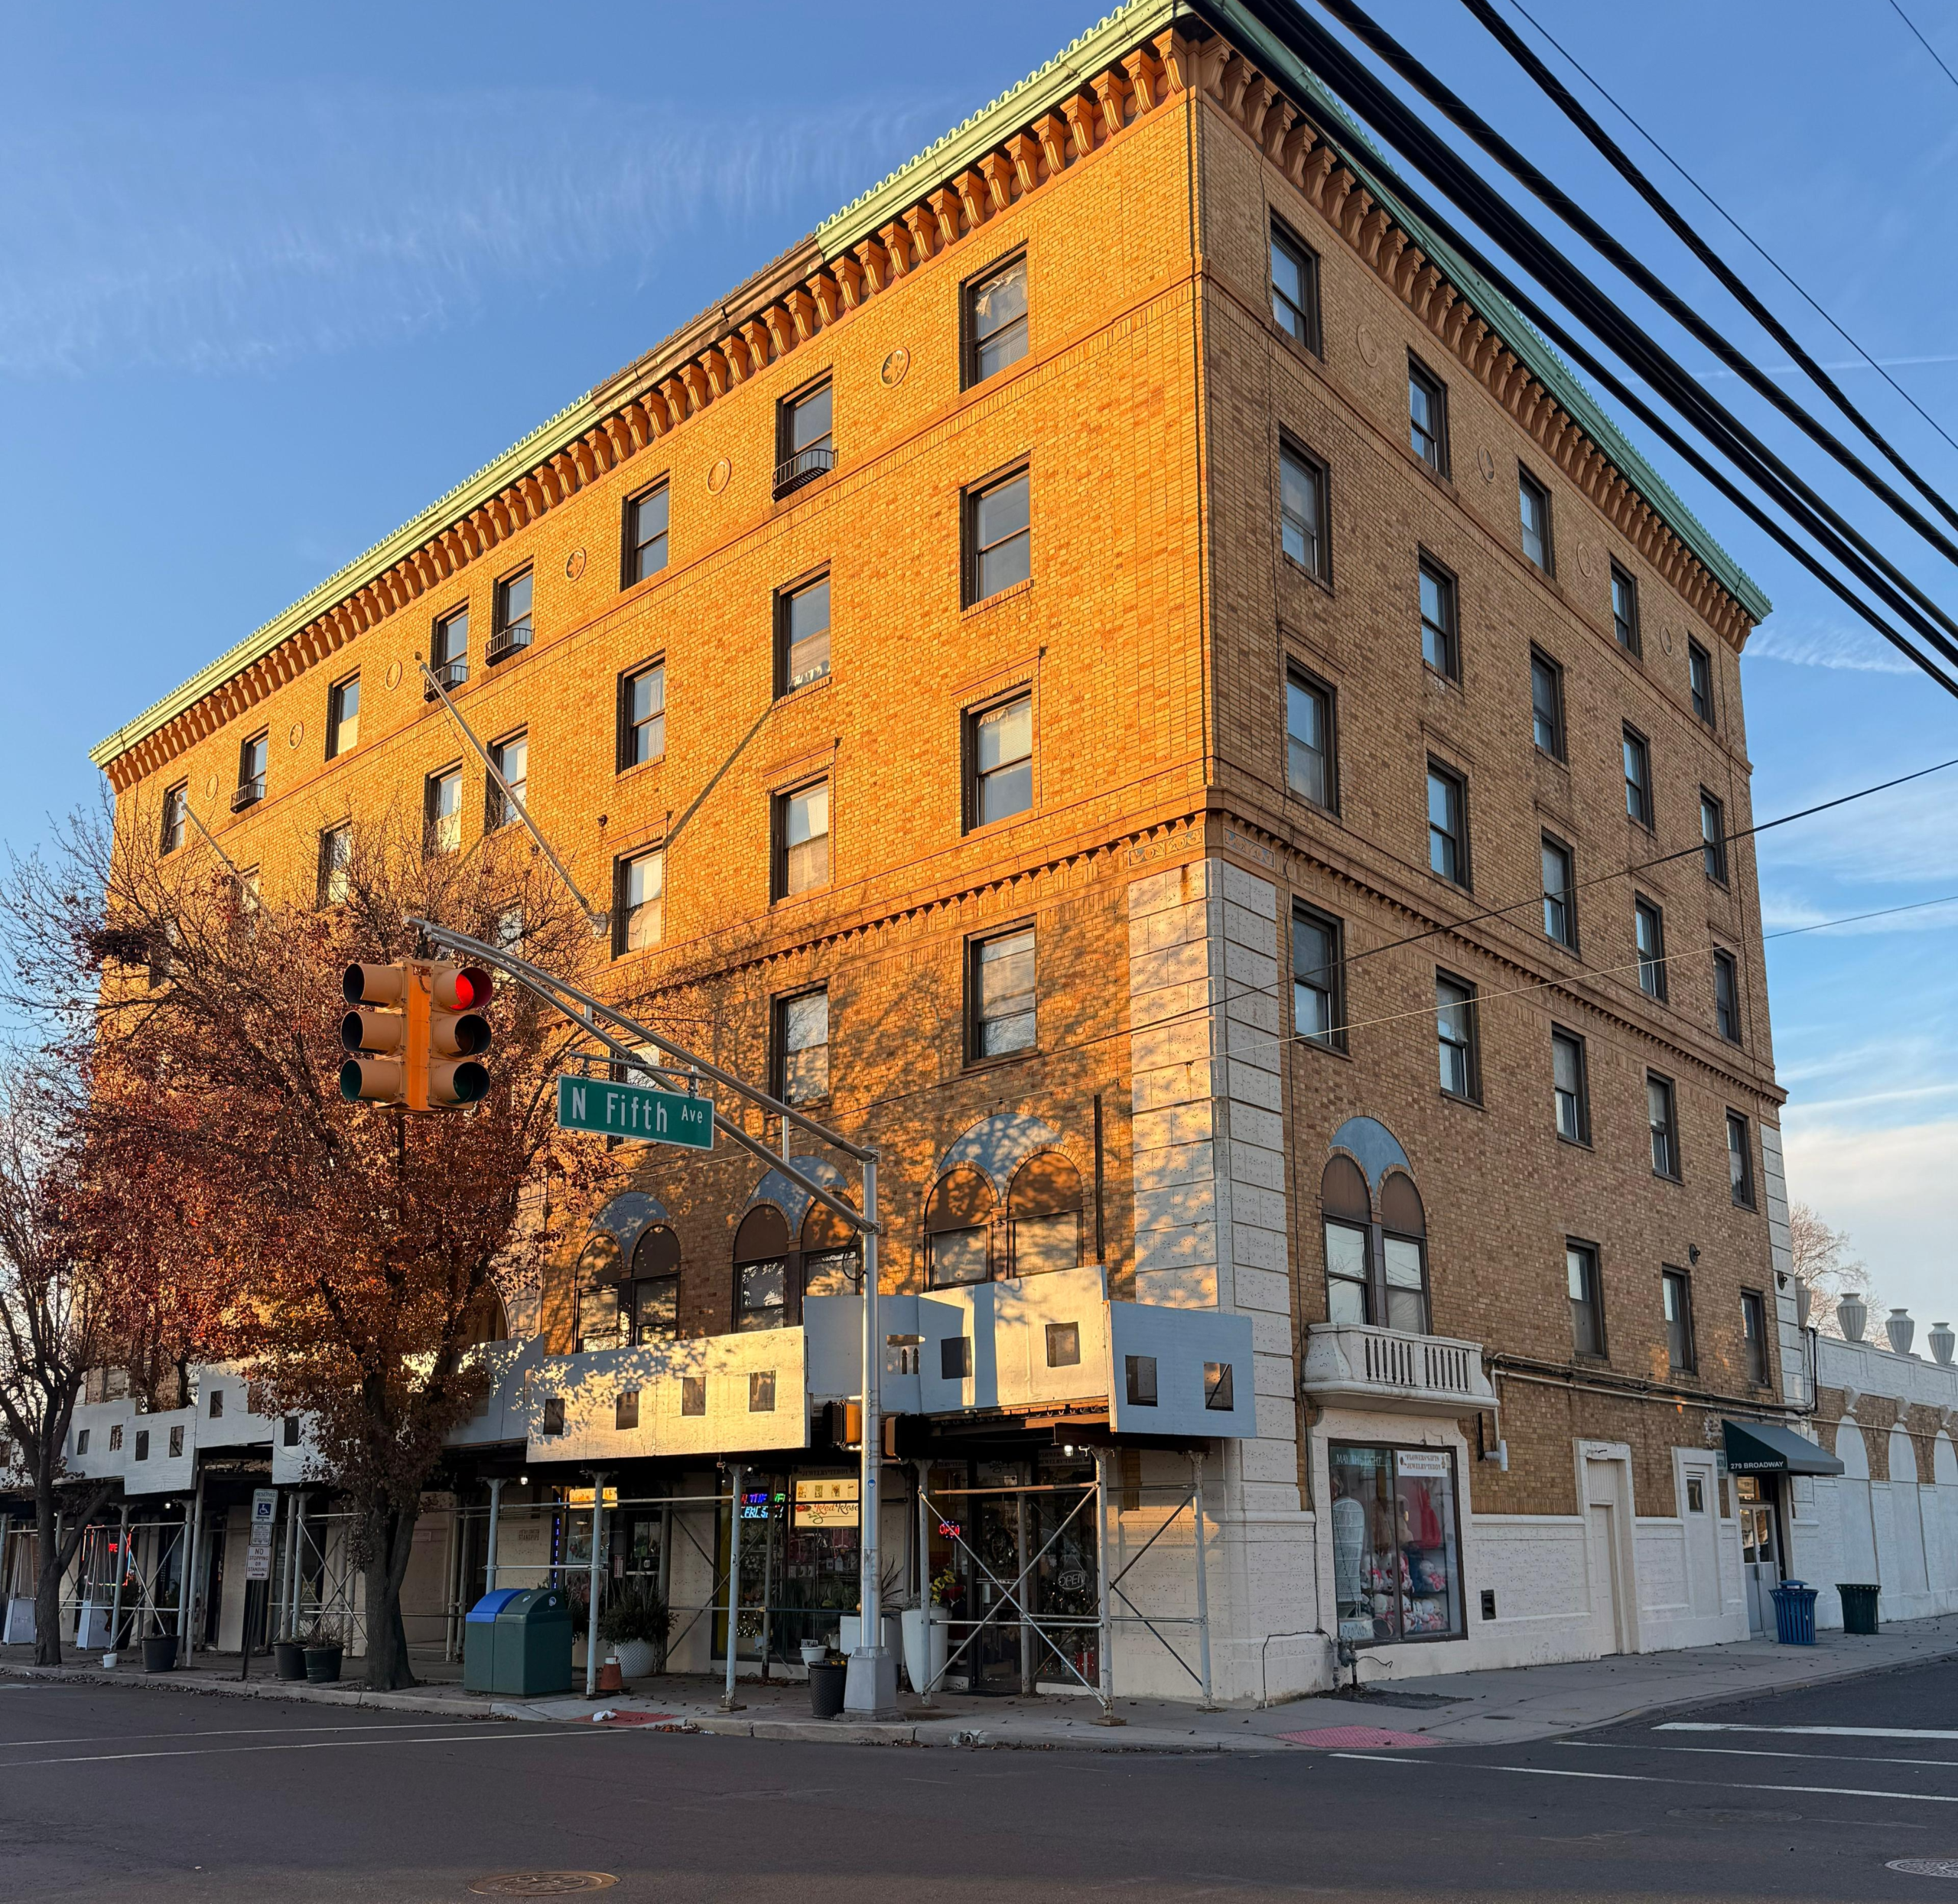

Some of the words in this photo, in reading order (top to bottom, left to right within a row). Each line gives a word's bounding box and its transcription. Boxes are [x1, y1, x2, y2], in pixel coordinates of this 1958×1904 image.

[572, 1086, 586, 1121] N
[607, 1092, 668, 1133] Fifth
[681, 1105, 703, 1124] Ave
[1336, 1453, 1348, 1464] MAY
[1743, 1460, 1784, 1469] BROADWAY
[1058, 1573, 1085, 1587] OPEN
